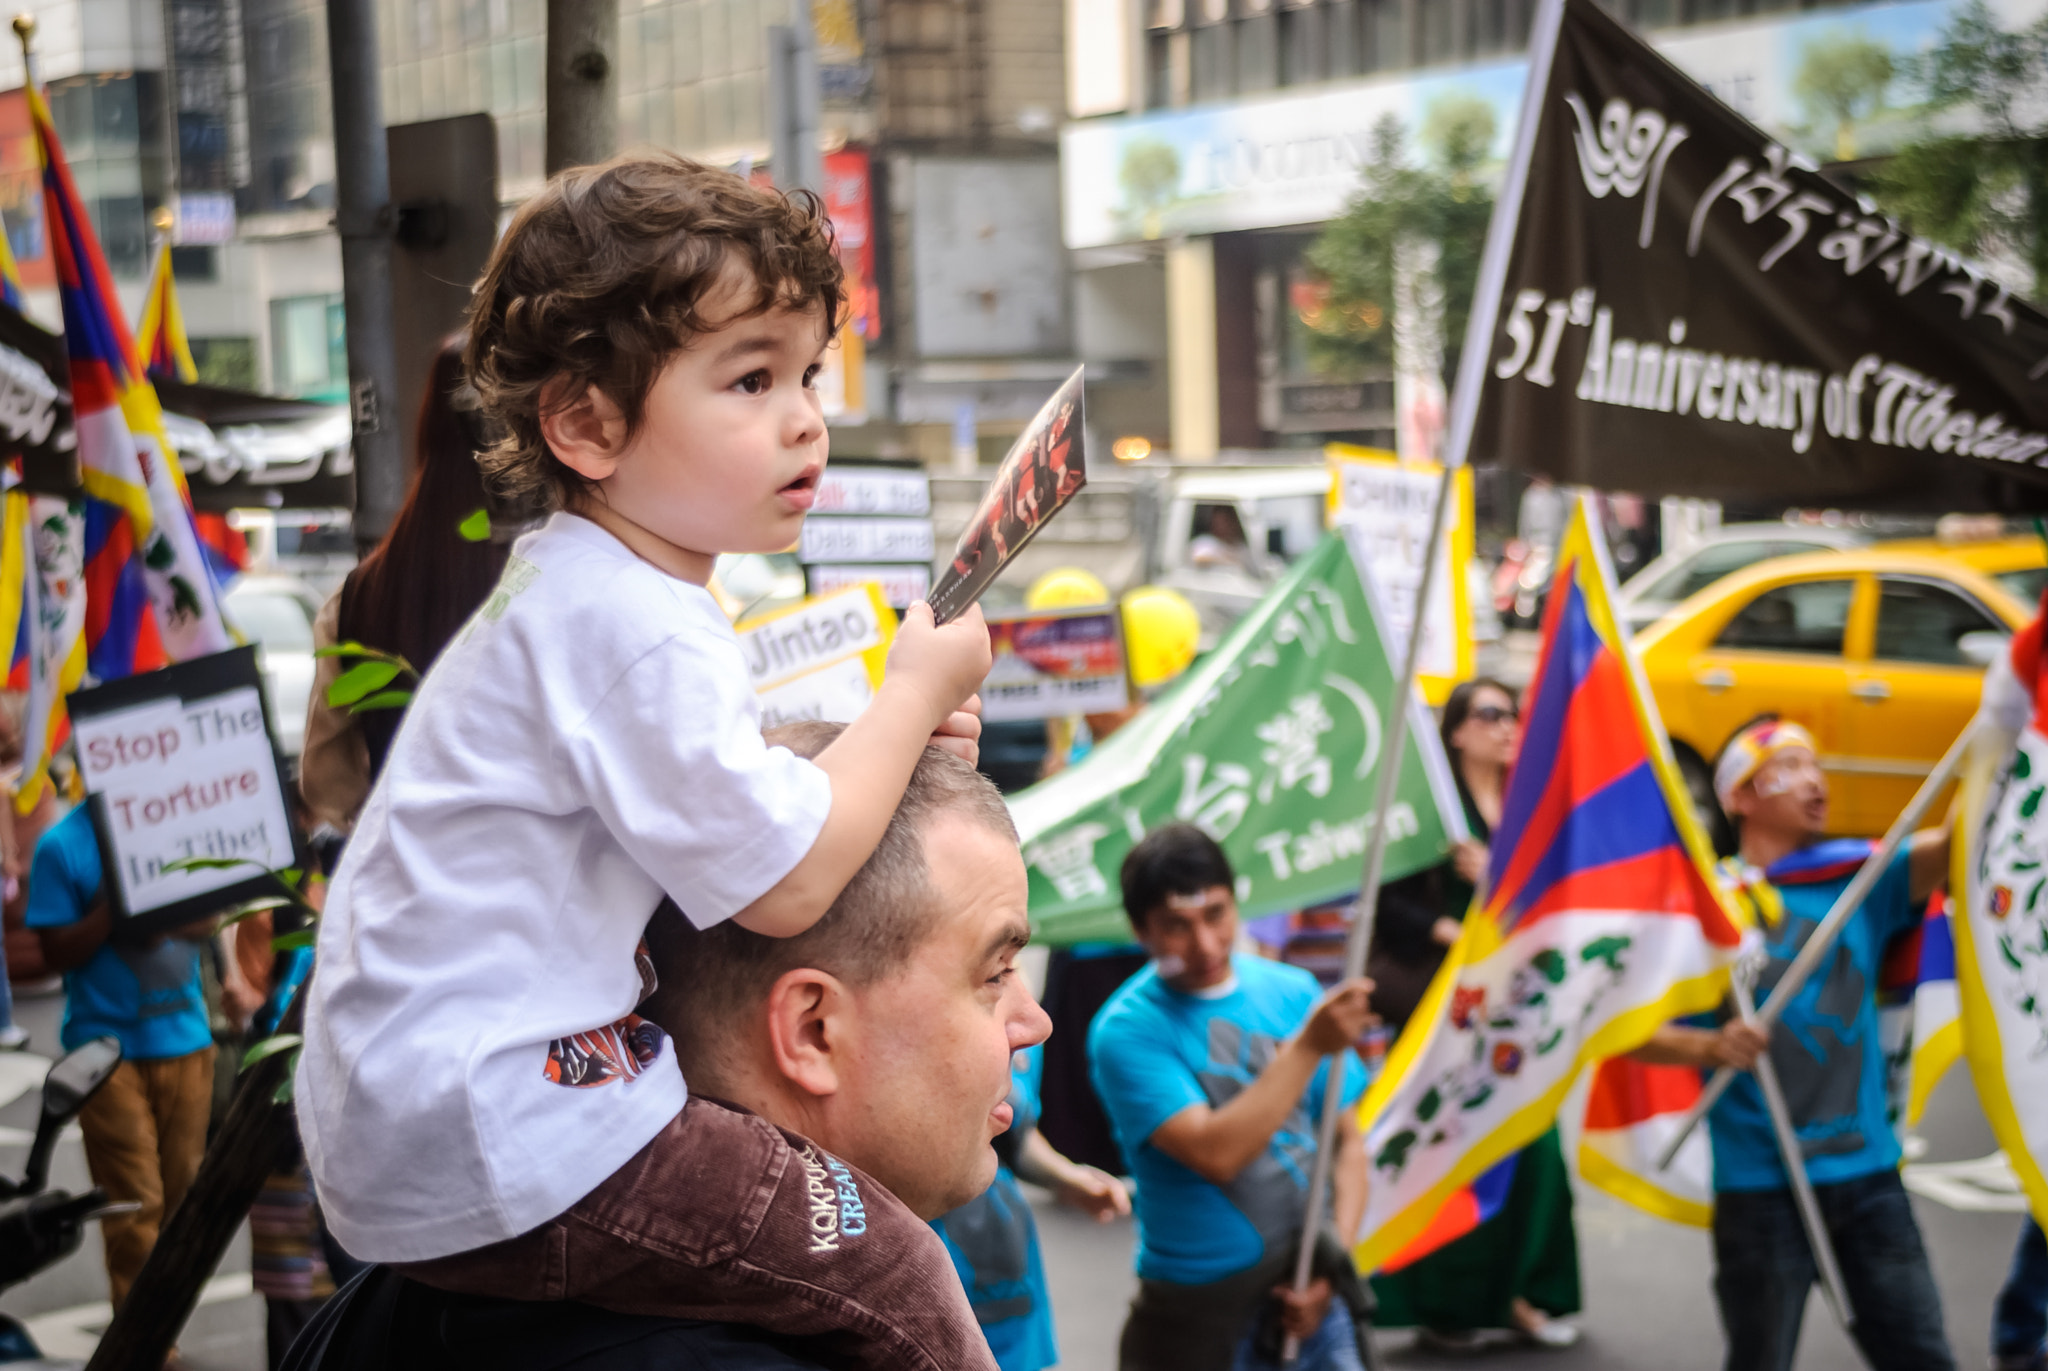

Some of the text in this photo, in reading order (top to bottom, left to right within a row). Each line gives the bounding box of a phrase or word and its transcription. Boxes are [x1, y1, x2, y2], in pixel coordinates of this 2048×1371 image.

[1576, 305, 1820, 454] Anniversary
[1823, 353, 1881, 441] of
[88, 704, 259, 773] Stop The
[114, 768, 260, 831] Torture
